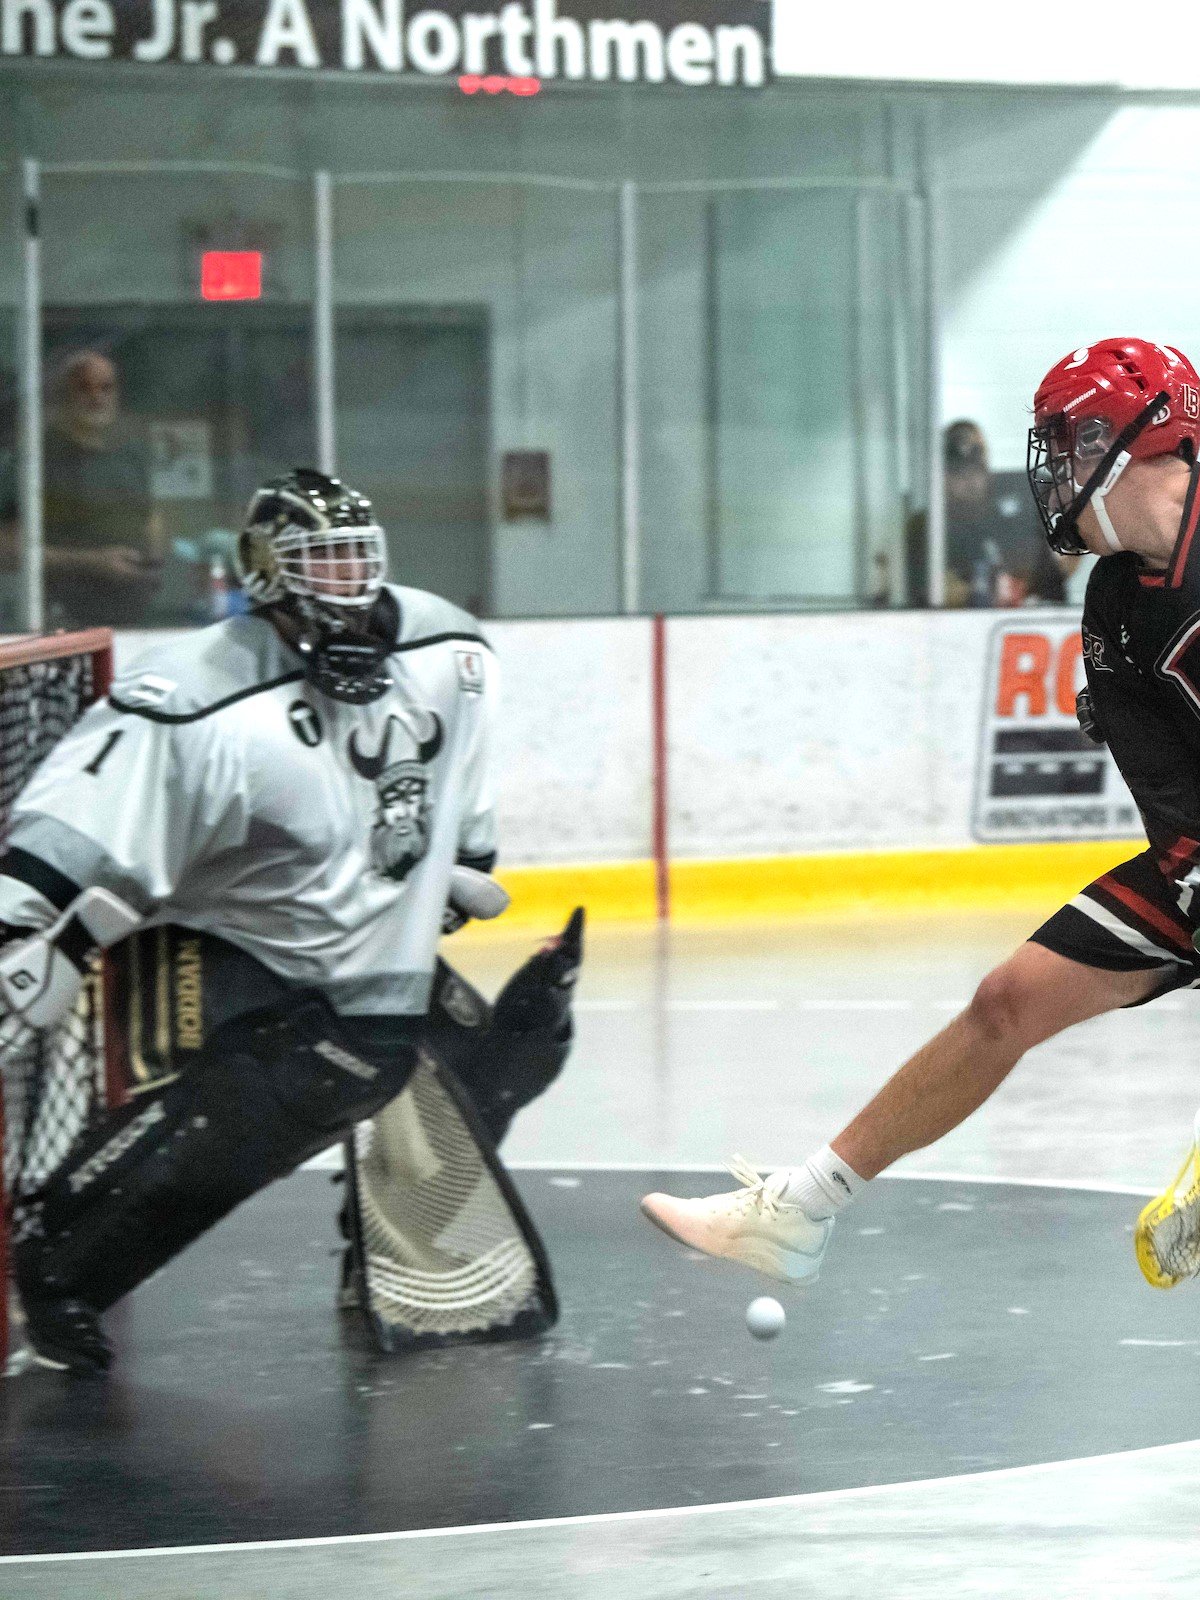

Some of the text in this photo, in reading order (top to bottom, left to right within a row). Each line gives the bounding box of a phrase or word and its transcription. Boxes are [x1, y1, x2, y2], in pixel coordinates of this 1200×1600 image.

[133, 0, 236, 64] Jr.
[254, 0, 320, 68] A
[341, 0, 764, 87] Northmen
[83, 729, 124, 776] 1
